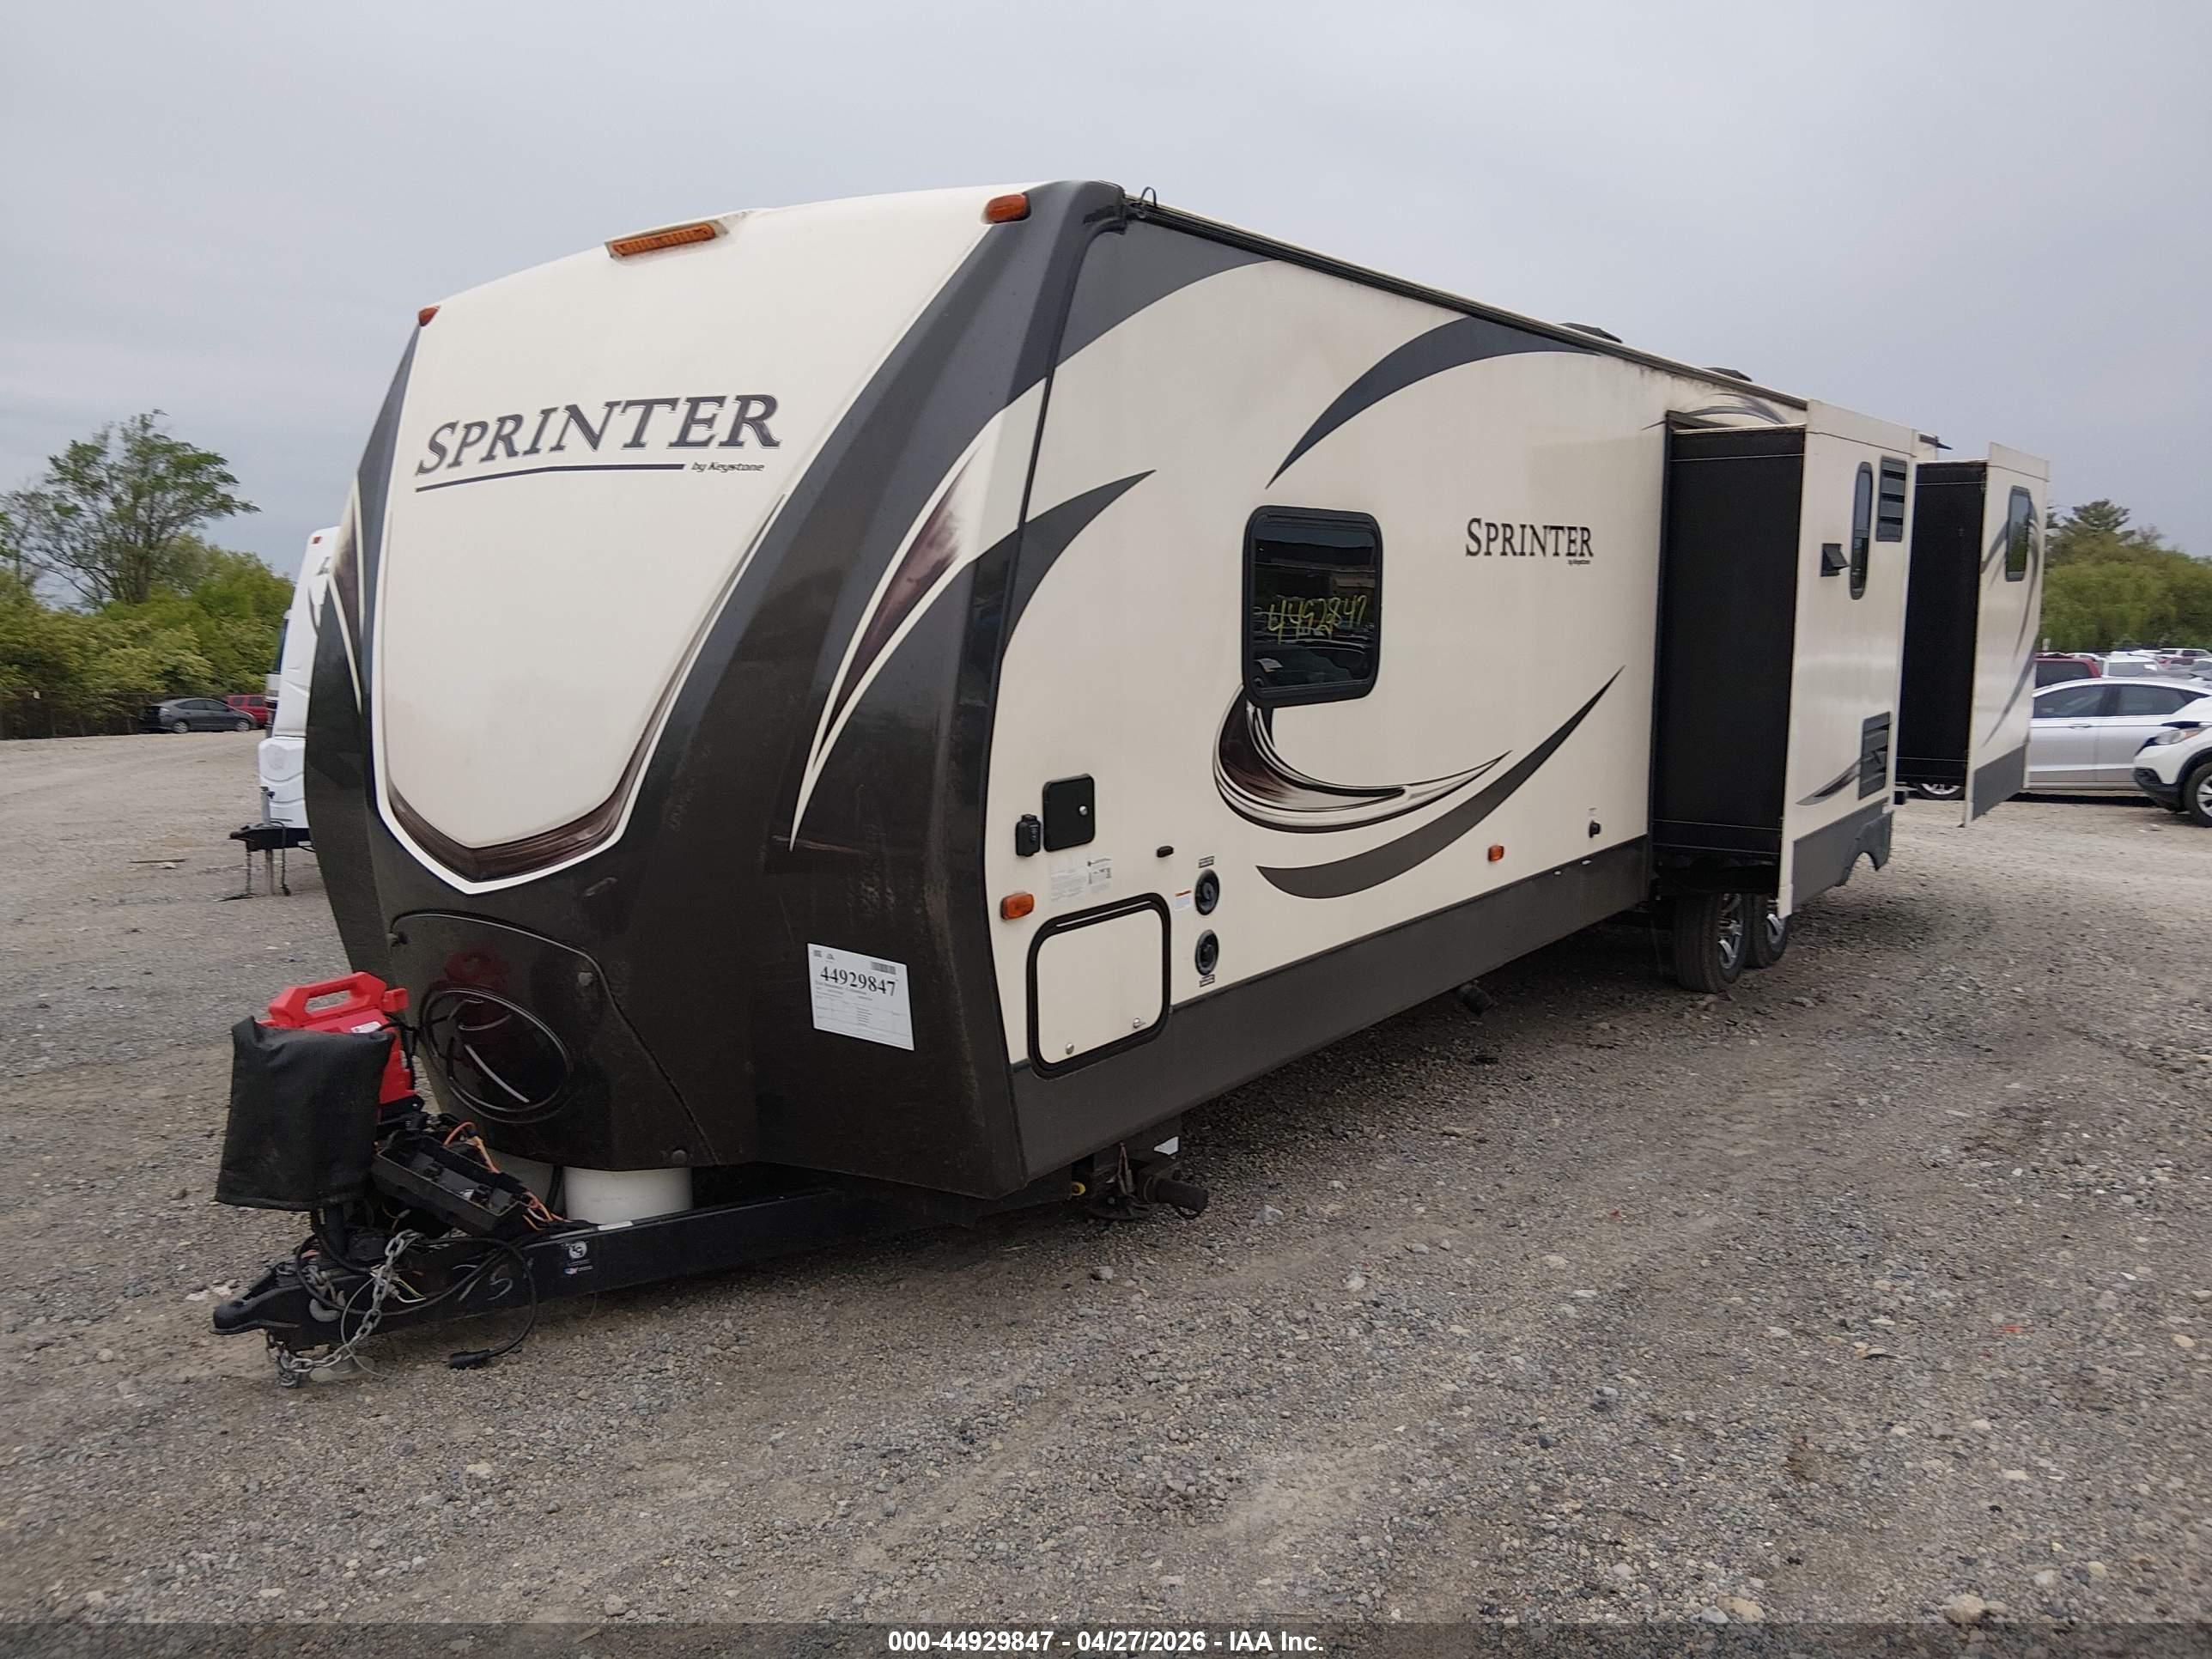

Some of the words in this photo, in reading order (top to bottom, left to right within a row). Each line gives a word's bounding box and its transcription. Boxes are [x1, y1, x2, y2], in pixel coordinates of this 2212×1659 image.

[416, 393, 782, 476] SPRINTER
[691, 461, 707, 473] by
[708, 462, 765, 473] Keystone
[1465, 517, 1595, 557] SPRINTER
[820, 966, 896, 997] 44929847
